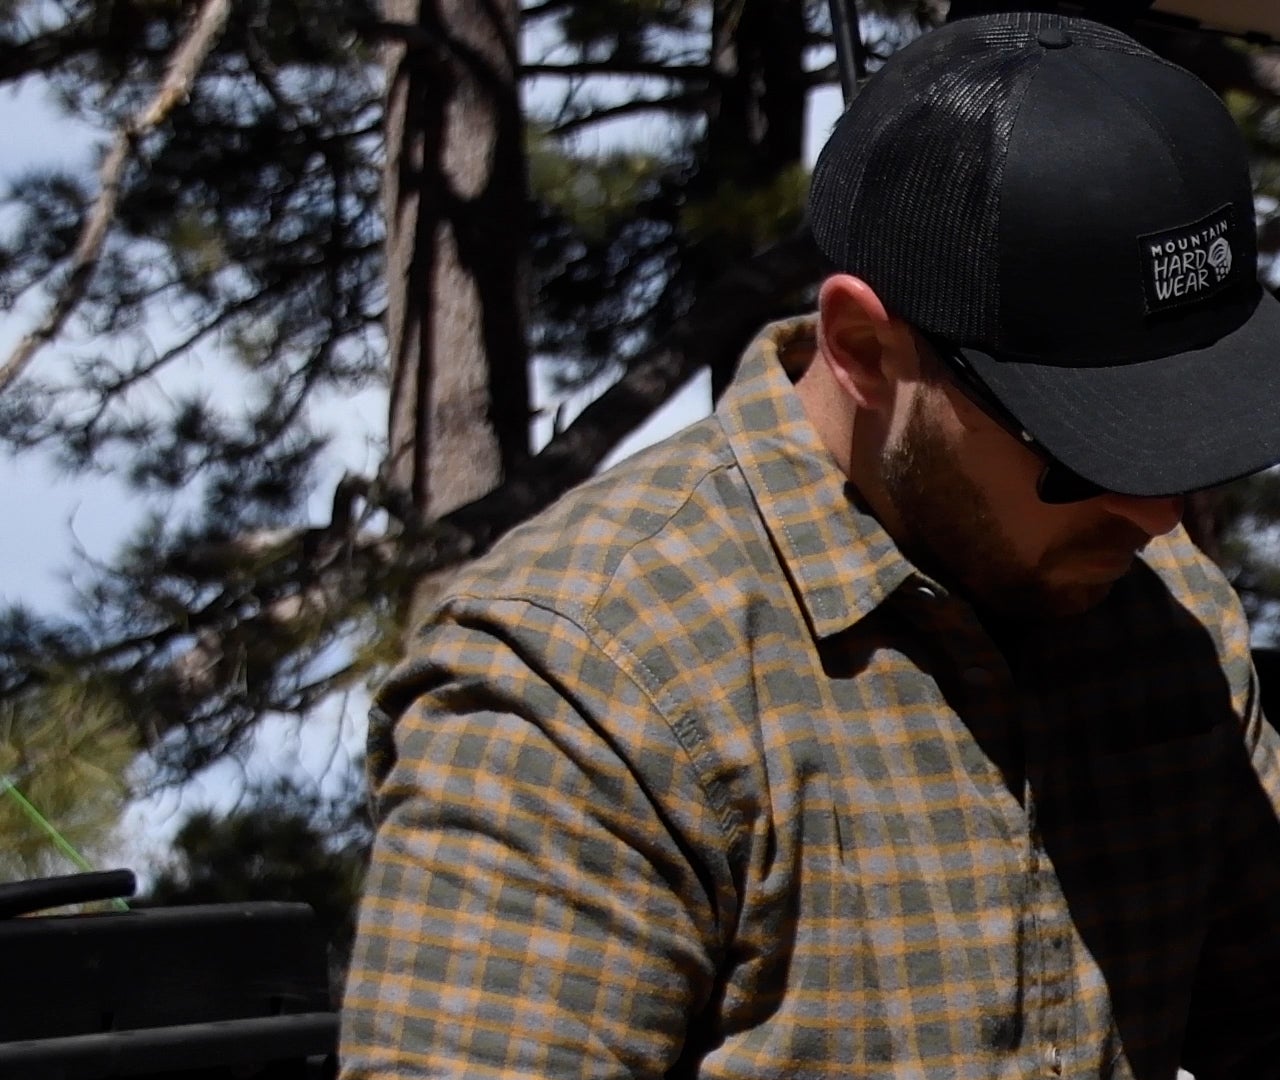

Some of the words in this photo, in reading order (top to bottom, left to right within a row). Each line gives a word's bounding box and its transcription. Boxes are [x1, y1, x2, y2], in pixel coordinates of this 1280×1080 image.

[1150, 220, 1228, 257] MOUNTAIN
[1154, 249, 1207, 280] HARD
[1155, 269, 1210, 300] WEAR
